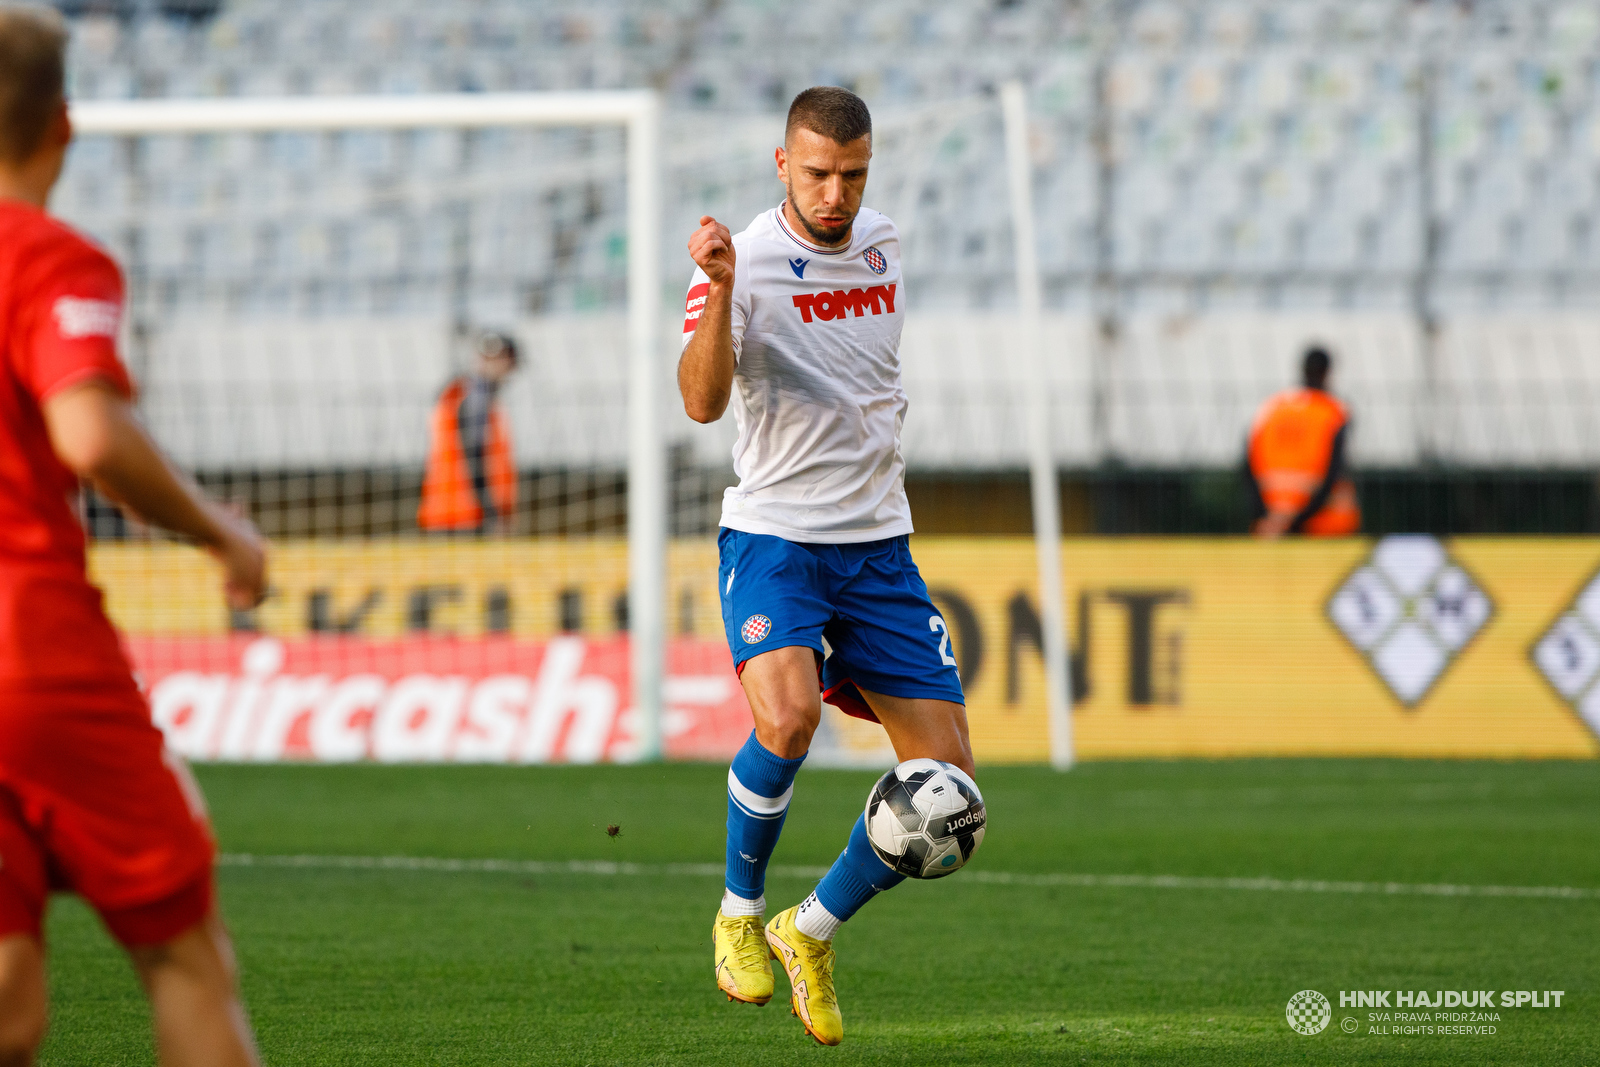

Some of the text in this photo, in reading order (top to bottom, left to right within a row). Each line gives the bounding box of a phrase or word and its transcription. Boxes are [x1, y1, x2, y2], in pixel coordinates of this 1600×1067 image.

[792, 284, 897, 323] TOMMY
[928, 615, 957, 667] 2
[150, 637, 617, 763] aircash
